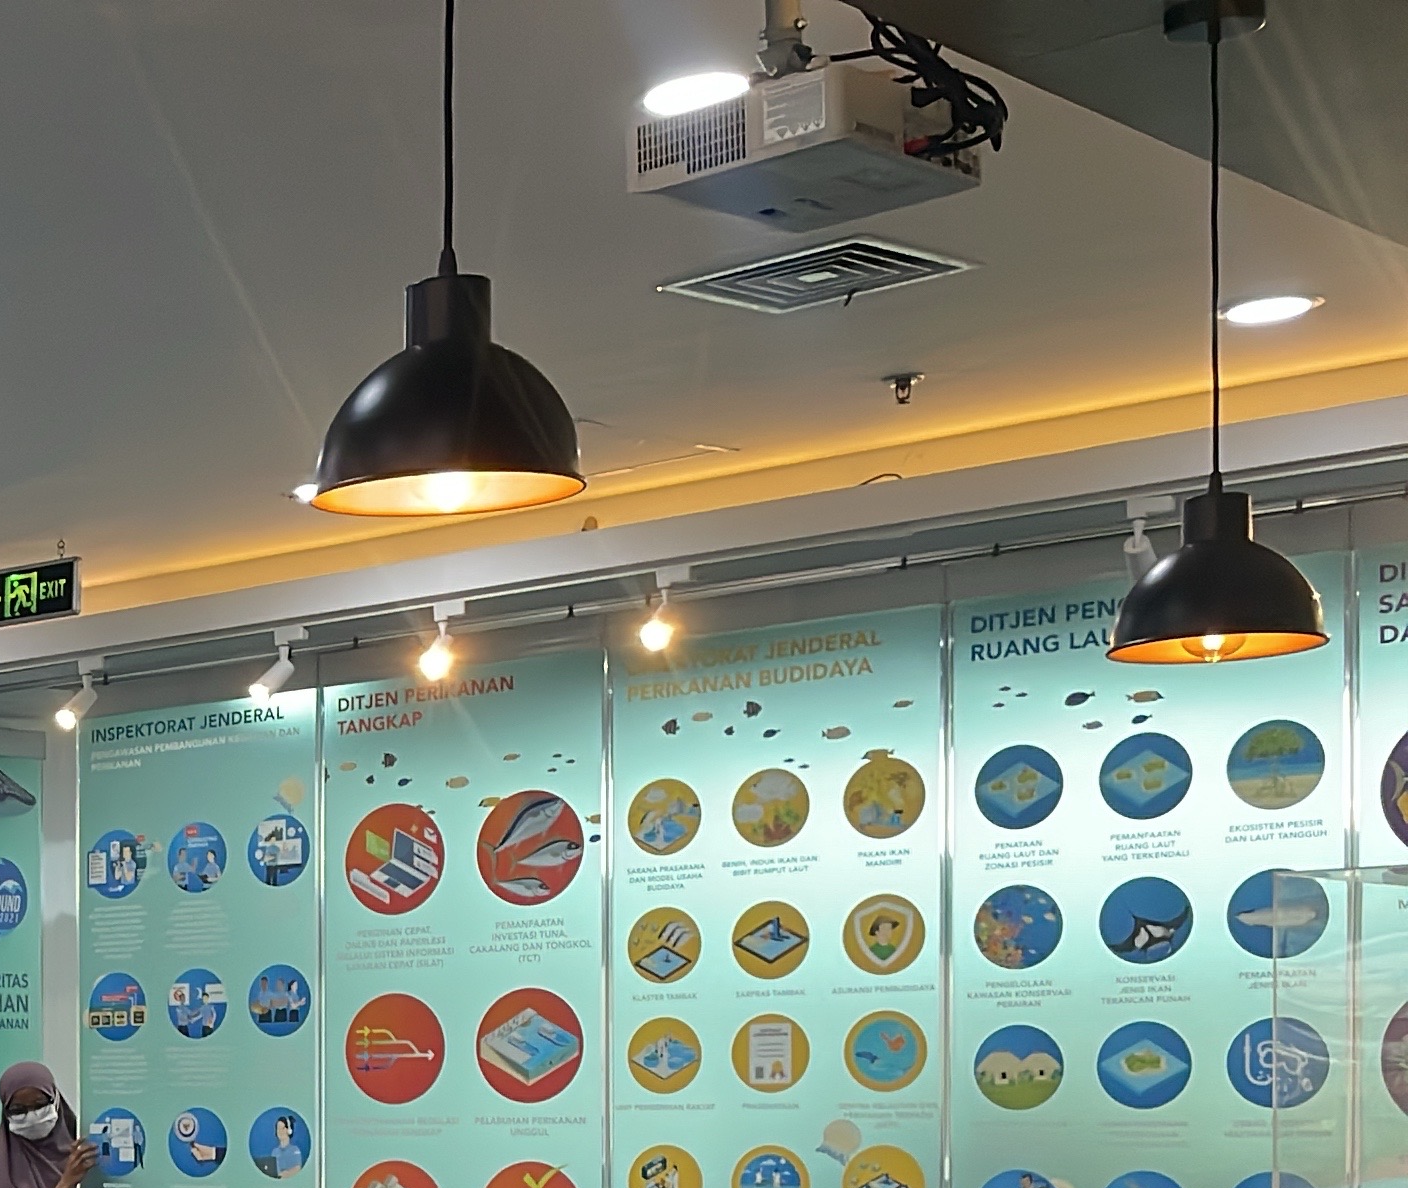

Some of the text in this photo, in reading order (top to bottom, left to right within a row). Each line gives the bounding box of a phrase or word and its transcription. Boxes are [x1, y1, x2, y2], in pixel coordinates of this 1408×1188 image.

[39, 578, 66, 600] EXIT
[970, 608, 1056, 634] DITJEN
[765, 629, 882, 659] JENDERAL
[971, 633, 1060, 662] RUANG
[627, 656, 874, 702] PERIKANAN BUDIDAYA
[338, 675, 514, 712] DITJEN PERIKANAN
[91, 706, 284, 744] INSPEKTORAT JENDERAL
[338, 711, 423, 736] TANGKAP
[1224, 829, 1328, 844] DAN LAUT TANGGUH
[1229, 819, 1323, 833] EKOSISTEM PESISIR
[1115, 840, 1176, 852] RUANG LAUT
[0, 912, 19, 924] 2021
[546, 940, 592, 950] TONGKOL
